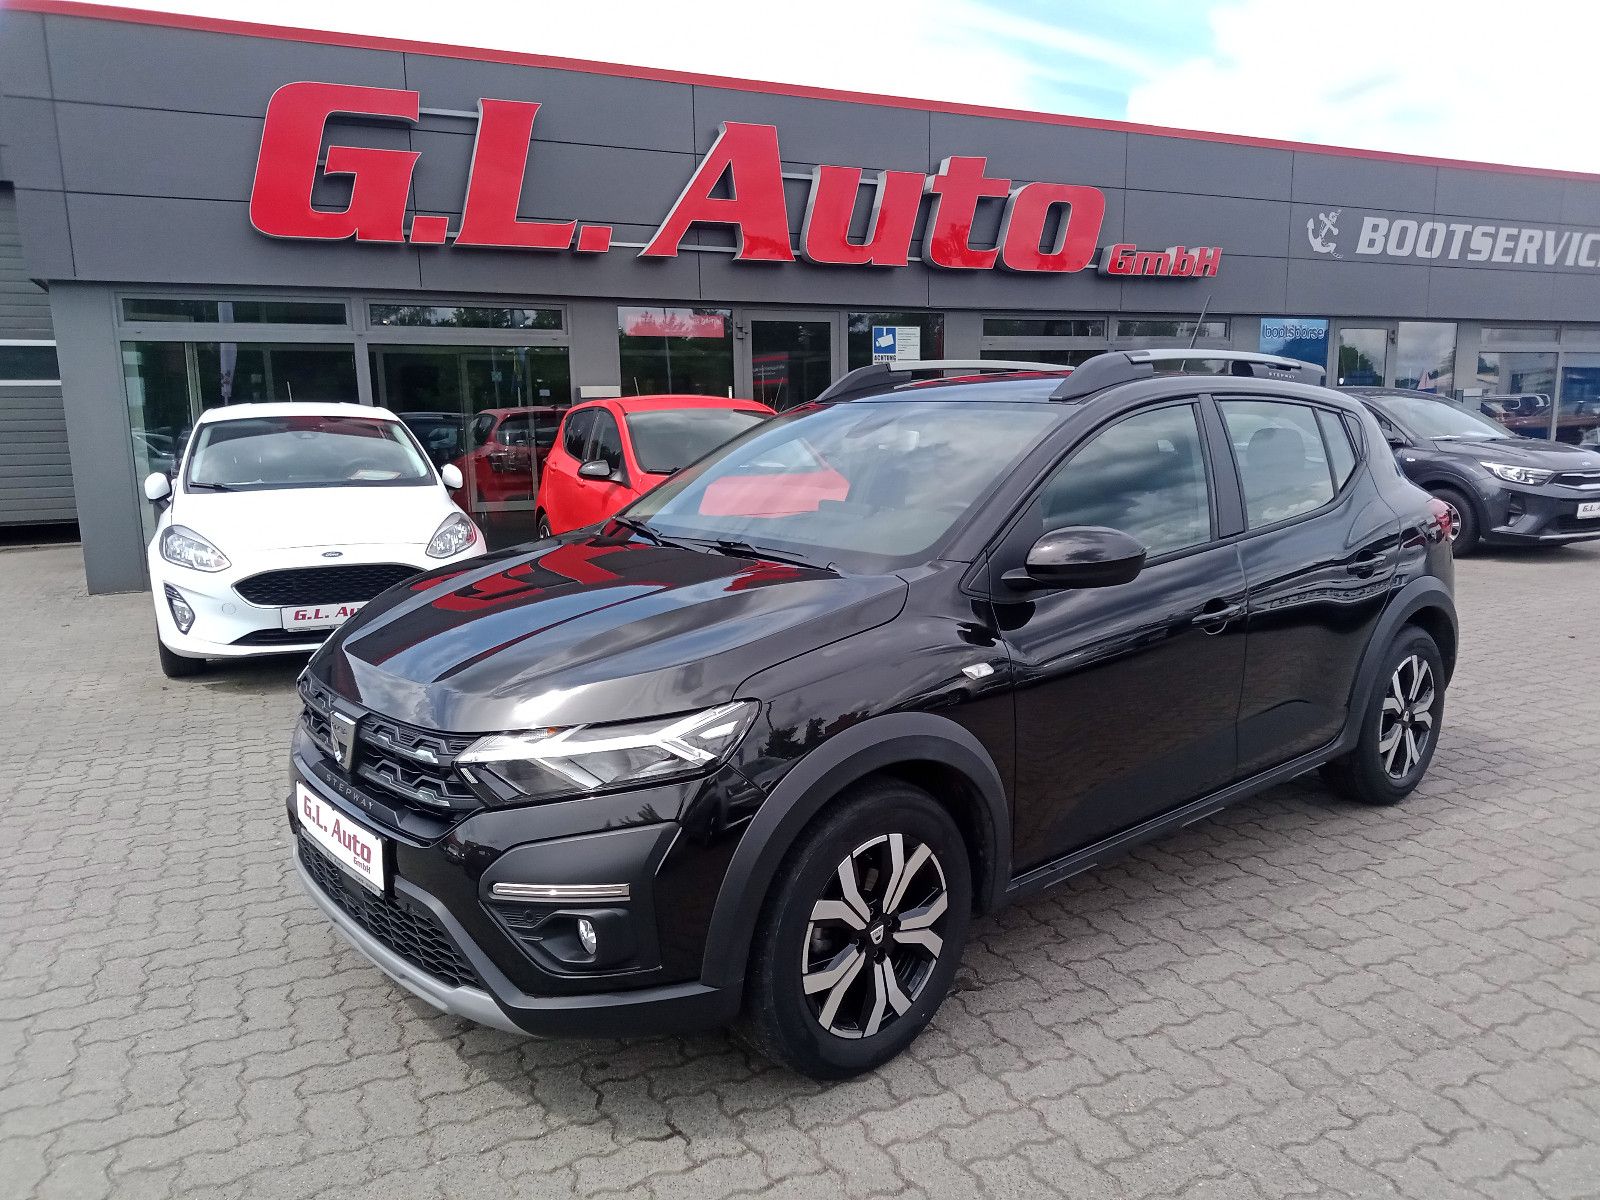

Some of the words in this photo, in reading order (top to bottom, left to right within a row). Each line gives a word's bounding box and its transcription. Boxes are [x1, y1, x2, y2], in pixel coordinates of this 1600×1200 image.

[250, 81, 613, 253] G.L.
[636, 121, 1106, 273] Auto
[1103, 243, 1223, 278] GmbH
[1355, 216, 1600, 268] BOOTSERVIC
[294, 608, 330, 621] G.L.
[326, 773, 375, 811] STEPWAY
[304, 794, 328, 833] G.L.
[331, 817, 372, 864] Auto
[353, 856, 371, 875] GmbH
